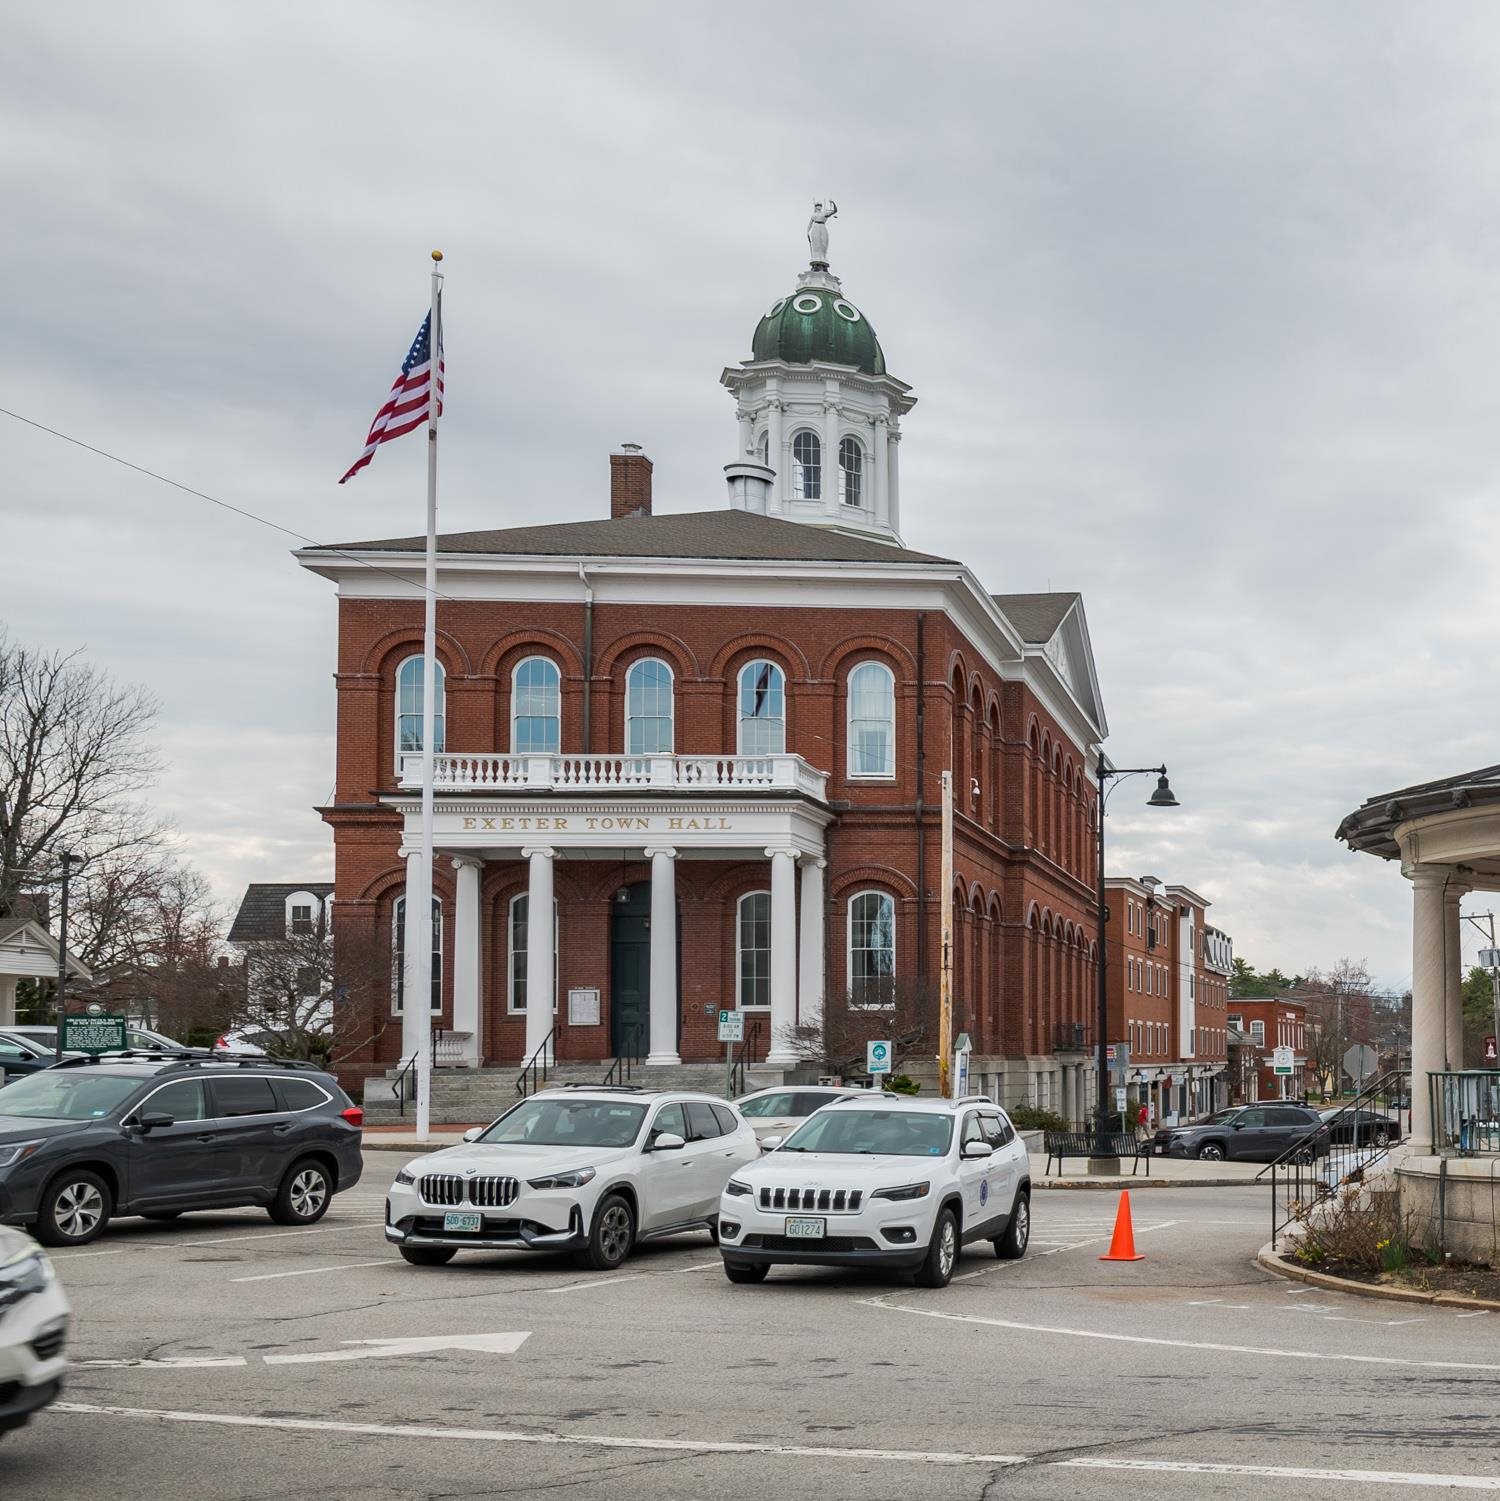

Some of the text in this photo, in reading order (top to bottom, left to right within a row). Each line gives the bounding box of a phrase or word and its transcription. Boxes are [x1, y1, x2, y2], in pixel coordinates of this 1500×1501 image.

[463, 817, 733, 830] EXETER TOWN HALL
[721, 1012, 728, 1021] 2
